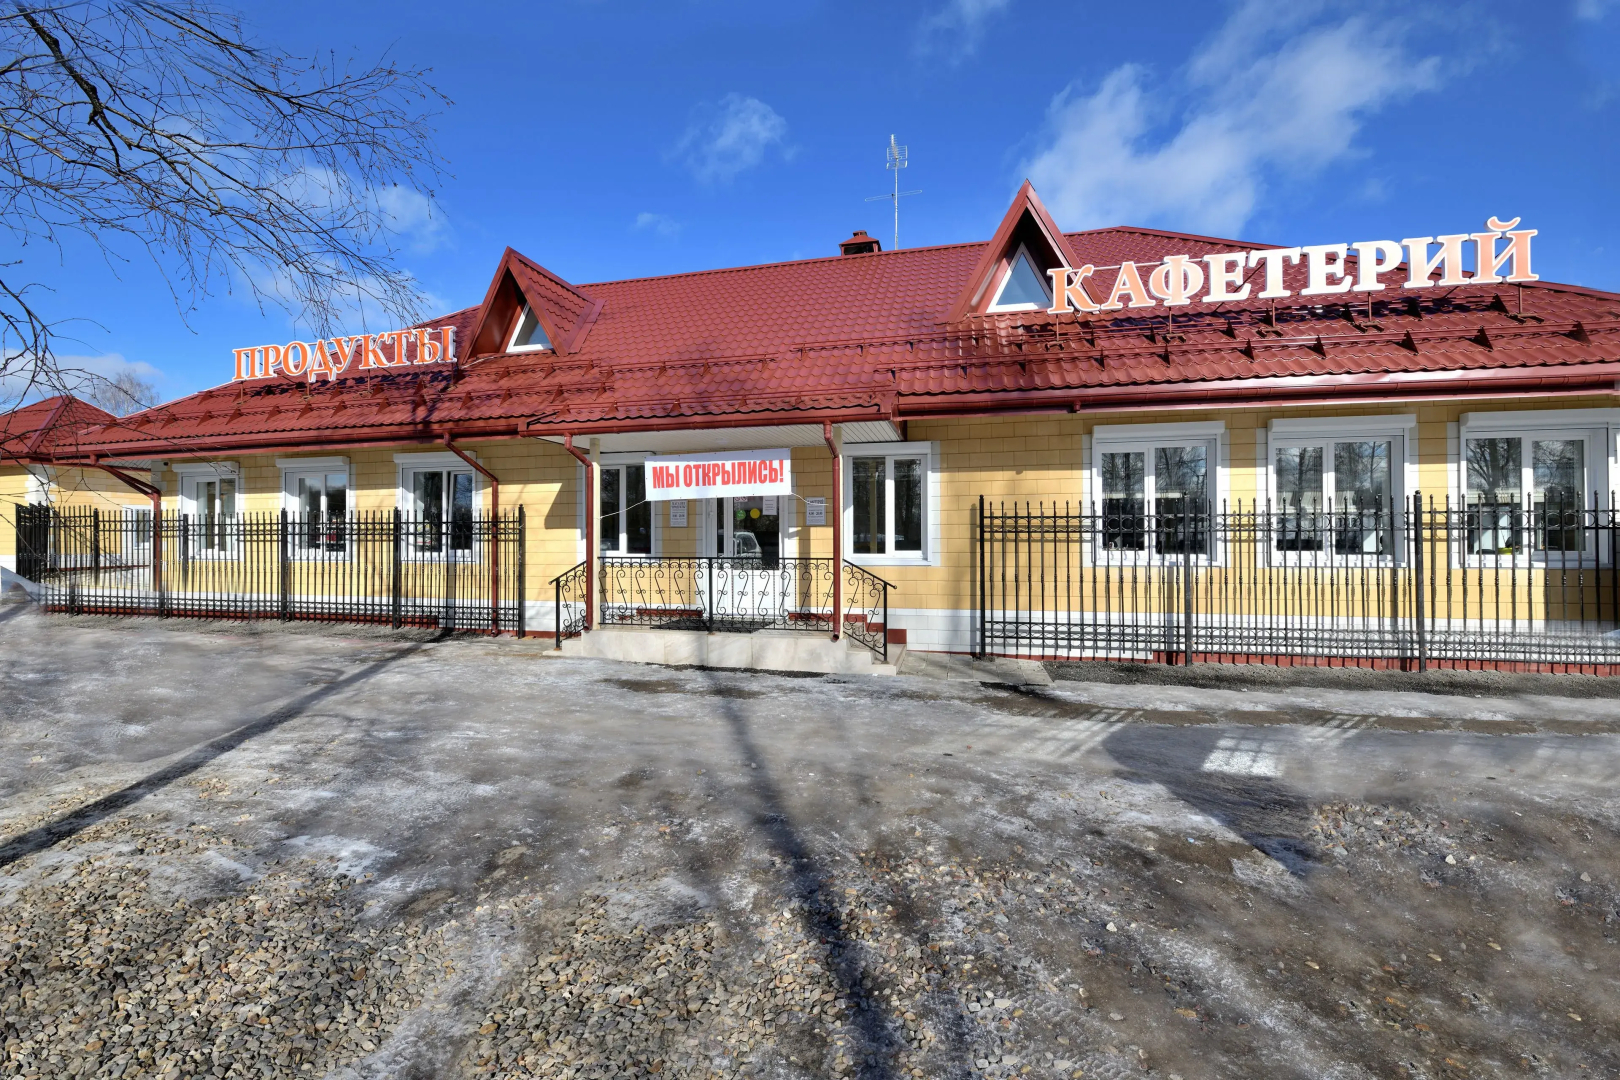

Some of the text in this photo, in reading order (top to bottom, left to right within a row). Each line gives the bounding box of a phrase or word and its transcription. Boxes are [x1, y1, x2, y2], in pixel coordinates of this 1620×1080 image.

[1046, 216, 1539, 314] КАФЕТЕРИЙ
[232, 326, 456, 382] ПРОДУКТЫ
[652, 459, 784, 488] МЫ ОТКРЫЛИСЬ!
